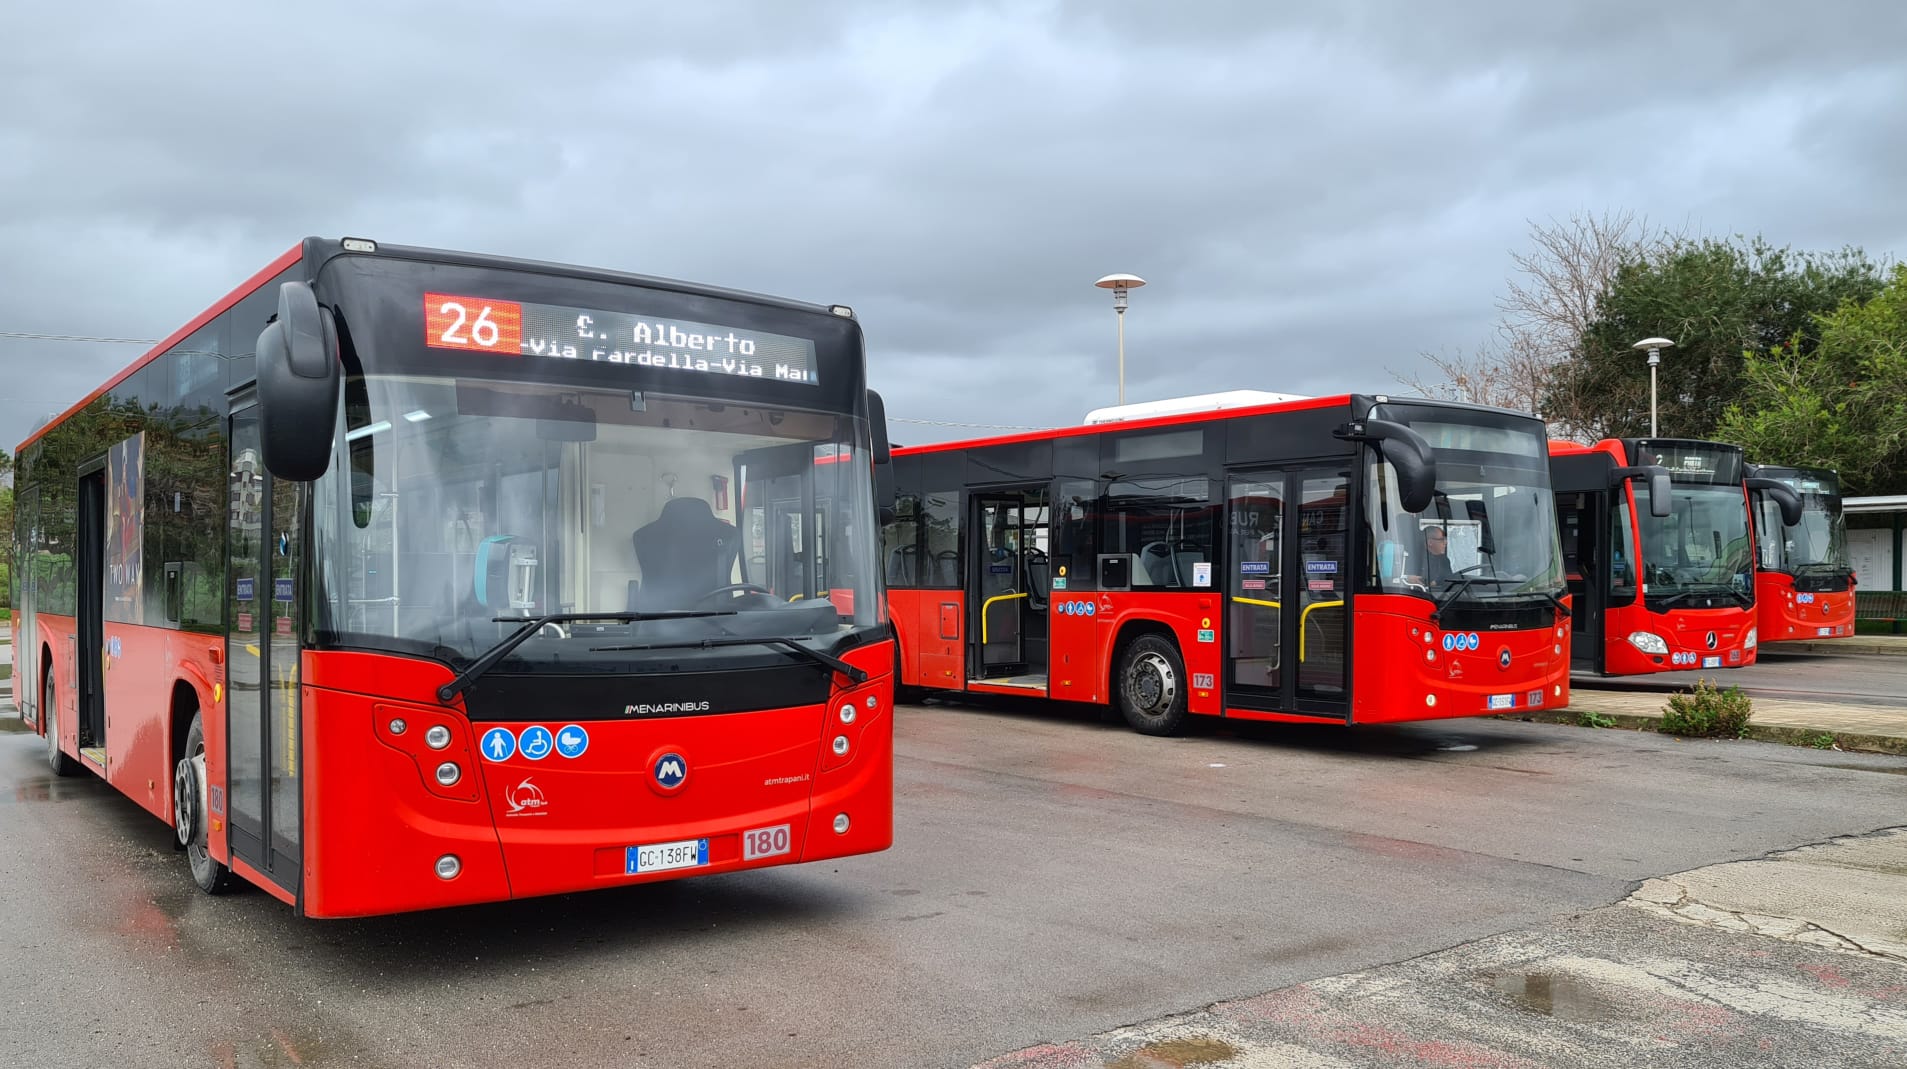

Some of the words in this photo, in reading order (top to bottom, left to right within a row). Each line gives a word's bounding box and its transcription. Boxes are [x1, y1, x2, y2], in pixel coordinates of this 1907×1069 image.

[440, 301, 499, 347] 26
[633, 321, 756, 356] Alberto
[109, 563, 122, 585] TWO
[1194, 674, 1213, 688] 173
[627, 701, 710, 714] MENARINIBUS
[1529, 691, 1542, 706] 173
[658, 760, 683, 779] M
[763, 773, 810, 786] atmtrapani.it
[211, 787, 223, 811] 180
[520, 798, 541, 806] atm
[746, 828, 788, 856] 180
